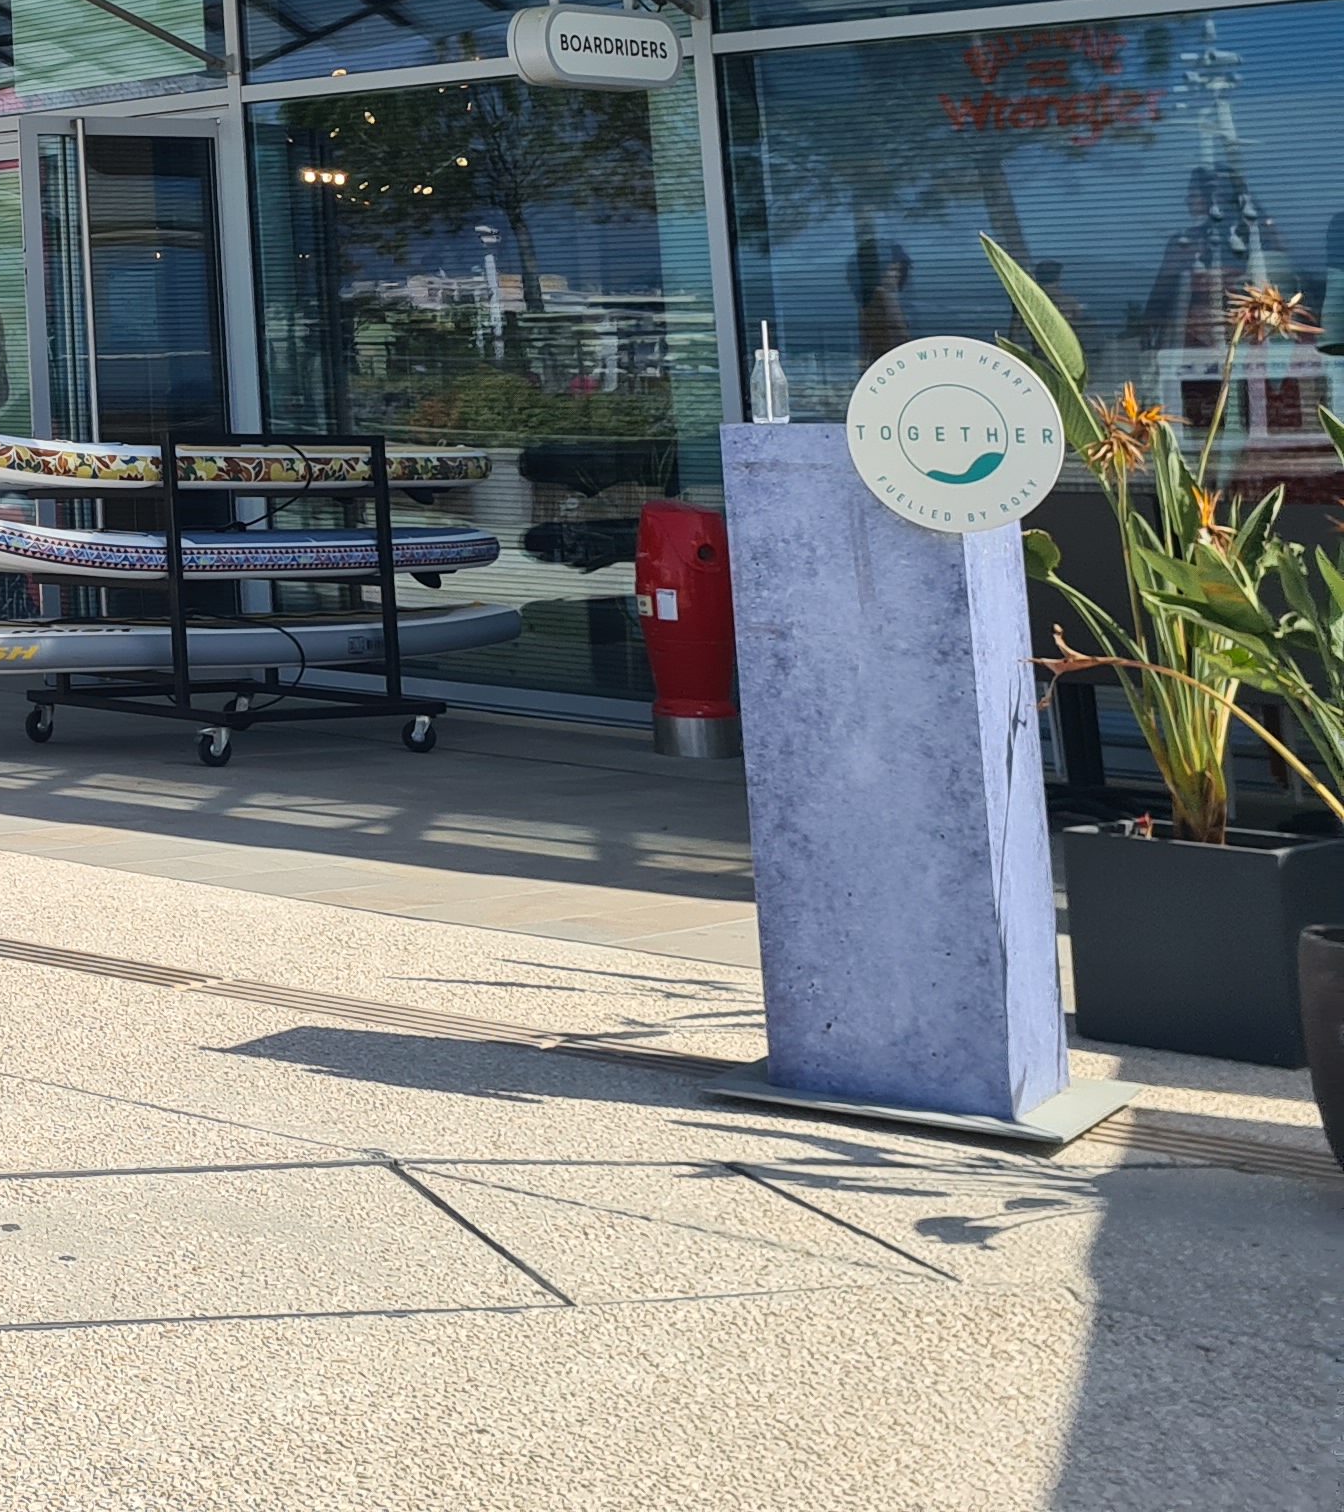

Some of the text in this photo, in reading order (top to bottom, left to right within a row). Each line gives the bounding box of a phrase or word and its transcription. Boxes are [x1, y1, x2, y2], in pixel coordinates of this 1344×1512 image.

[559, 33, 668, 59] BOARDRIDERS
[938, 84, 1167, 147] Wrangler
[869, 347, 1034, 397] FOOD WITH HEART
[855, 424, 1055, 444] TOGETHER
[876, 475, 1039, 523] FUELLED BY ROXY
